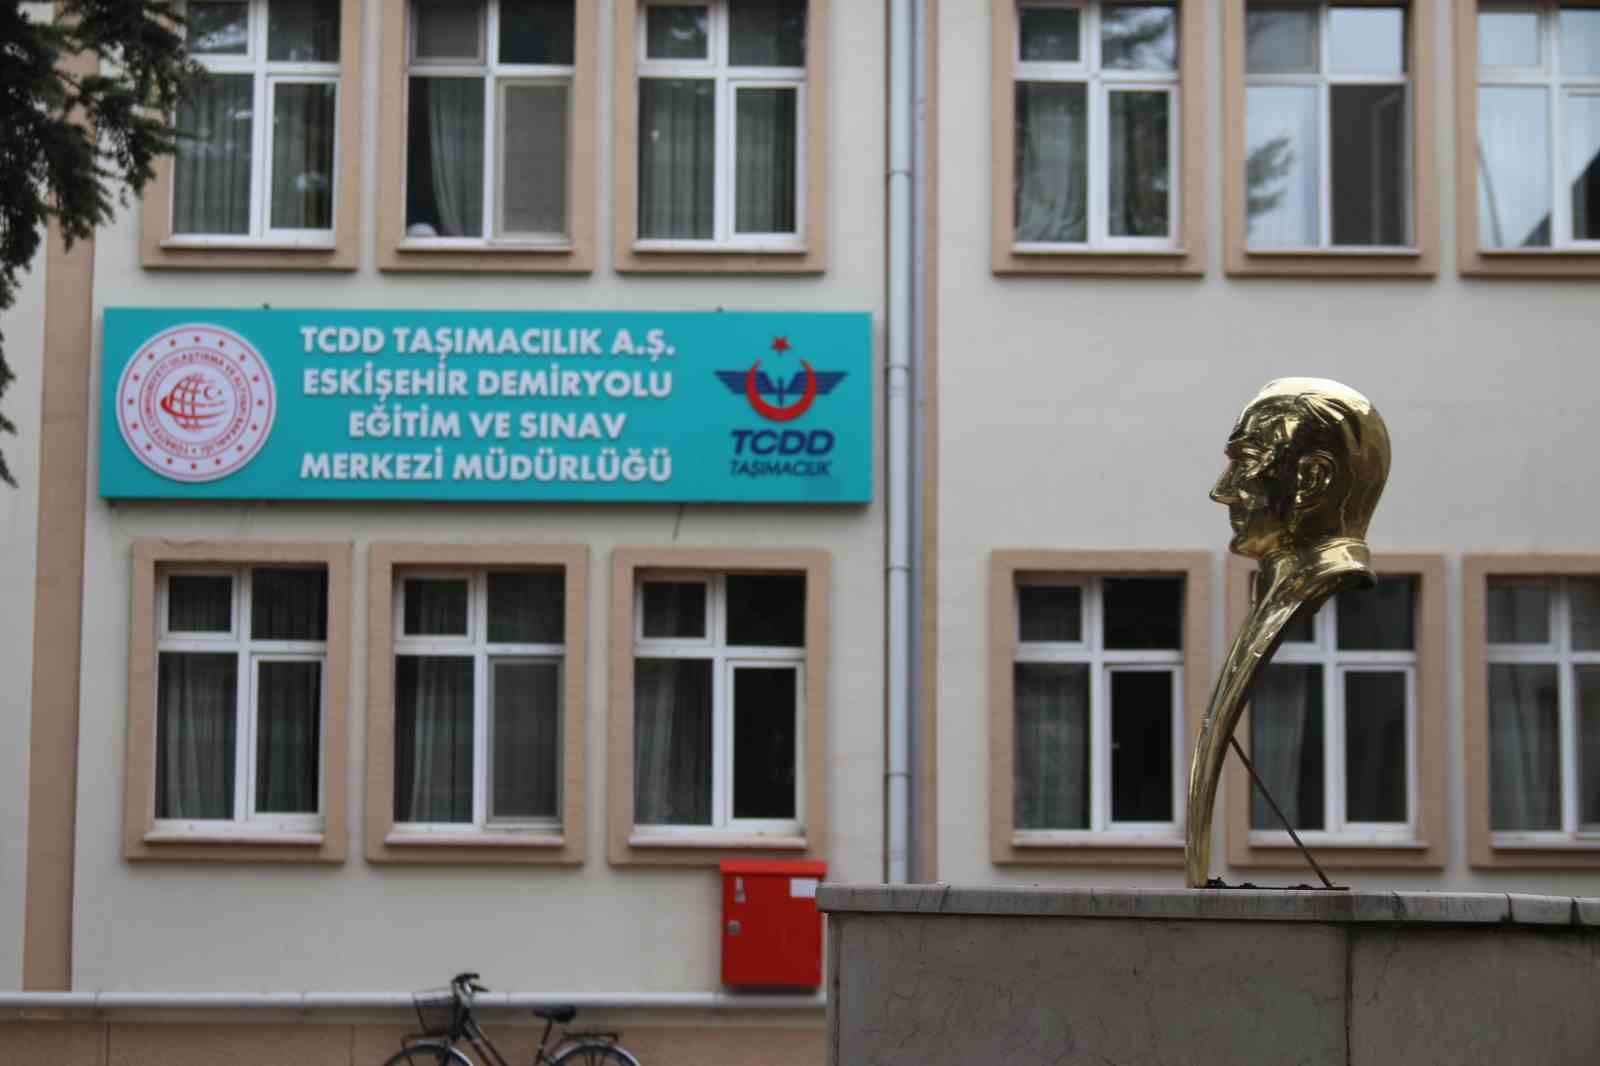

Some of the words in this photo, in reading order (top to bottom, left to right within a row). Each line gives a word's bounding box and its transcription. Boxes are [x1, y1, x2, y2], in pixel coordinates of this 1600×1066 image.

[301, 326, 385, 353] TCDD
[393, 327, 601, 360] TAŞIMACILIK
[611, 329, 676, 361] A.Ş.
[303, 361, 467, 402] ESKİŞEHİR
[477, 363, 673, 397] DEMİRYOLU
[349, 404, 460, 438] EĞİTİM
[469, 412, 511, 438] VE
[521, 412, 626, 438] SINAV
[730, 429, 835, 456] TCDD
[301, 447, 444, 480] MERKEZİ
[453, 447, 672, 481] MÜDÜRLÜĞÜ
